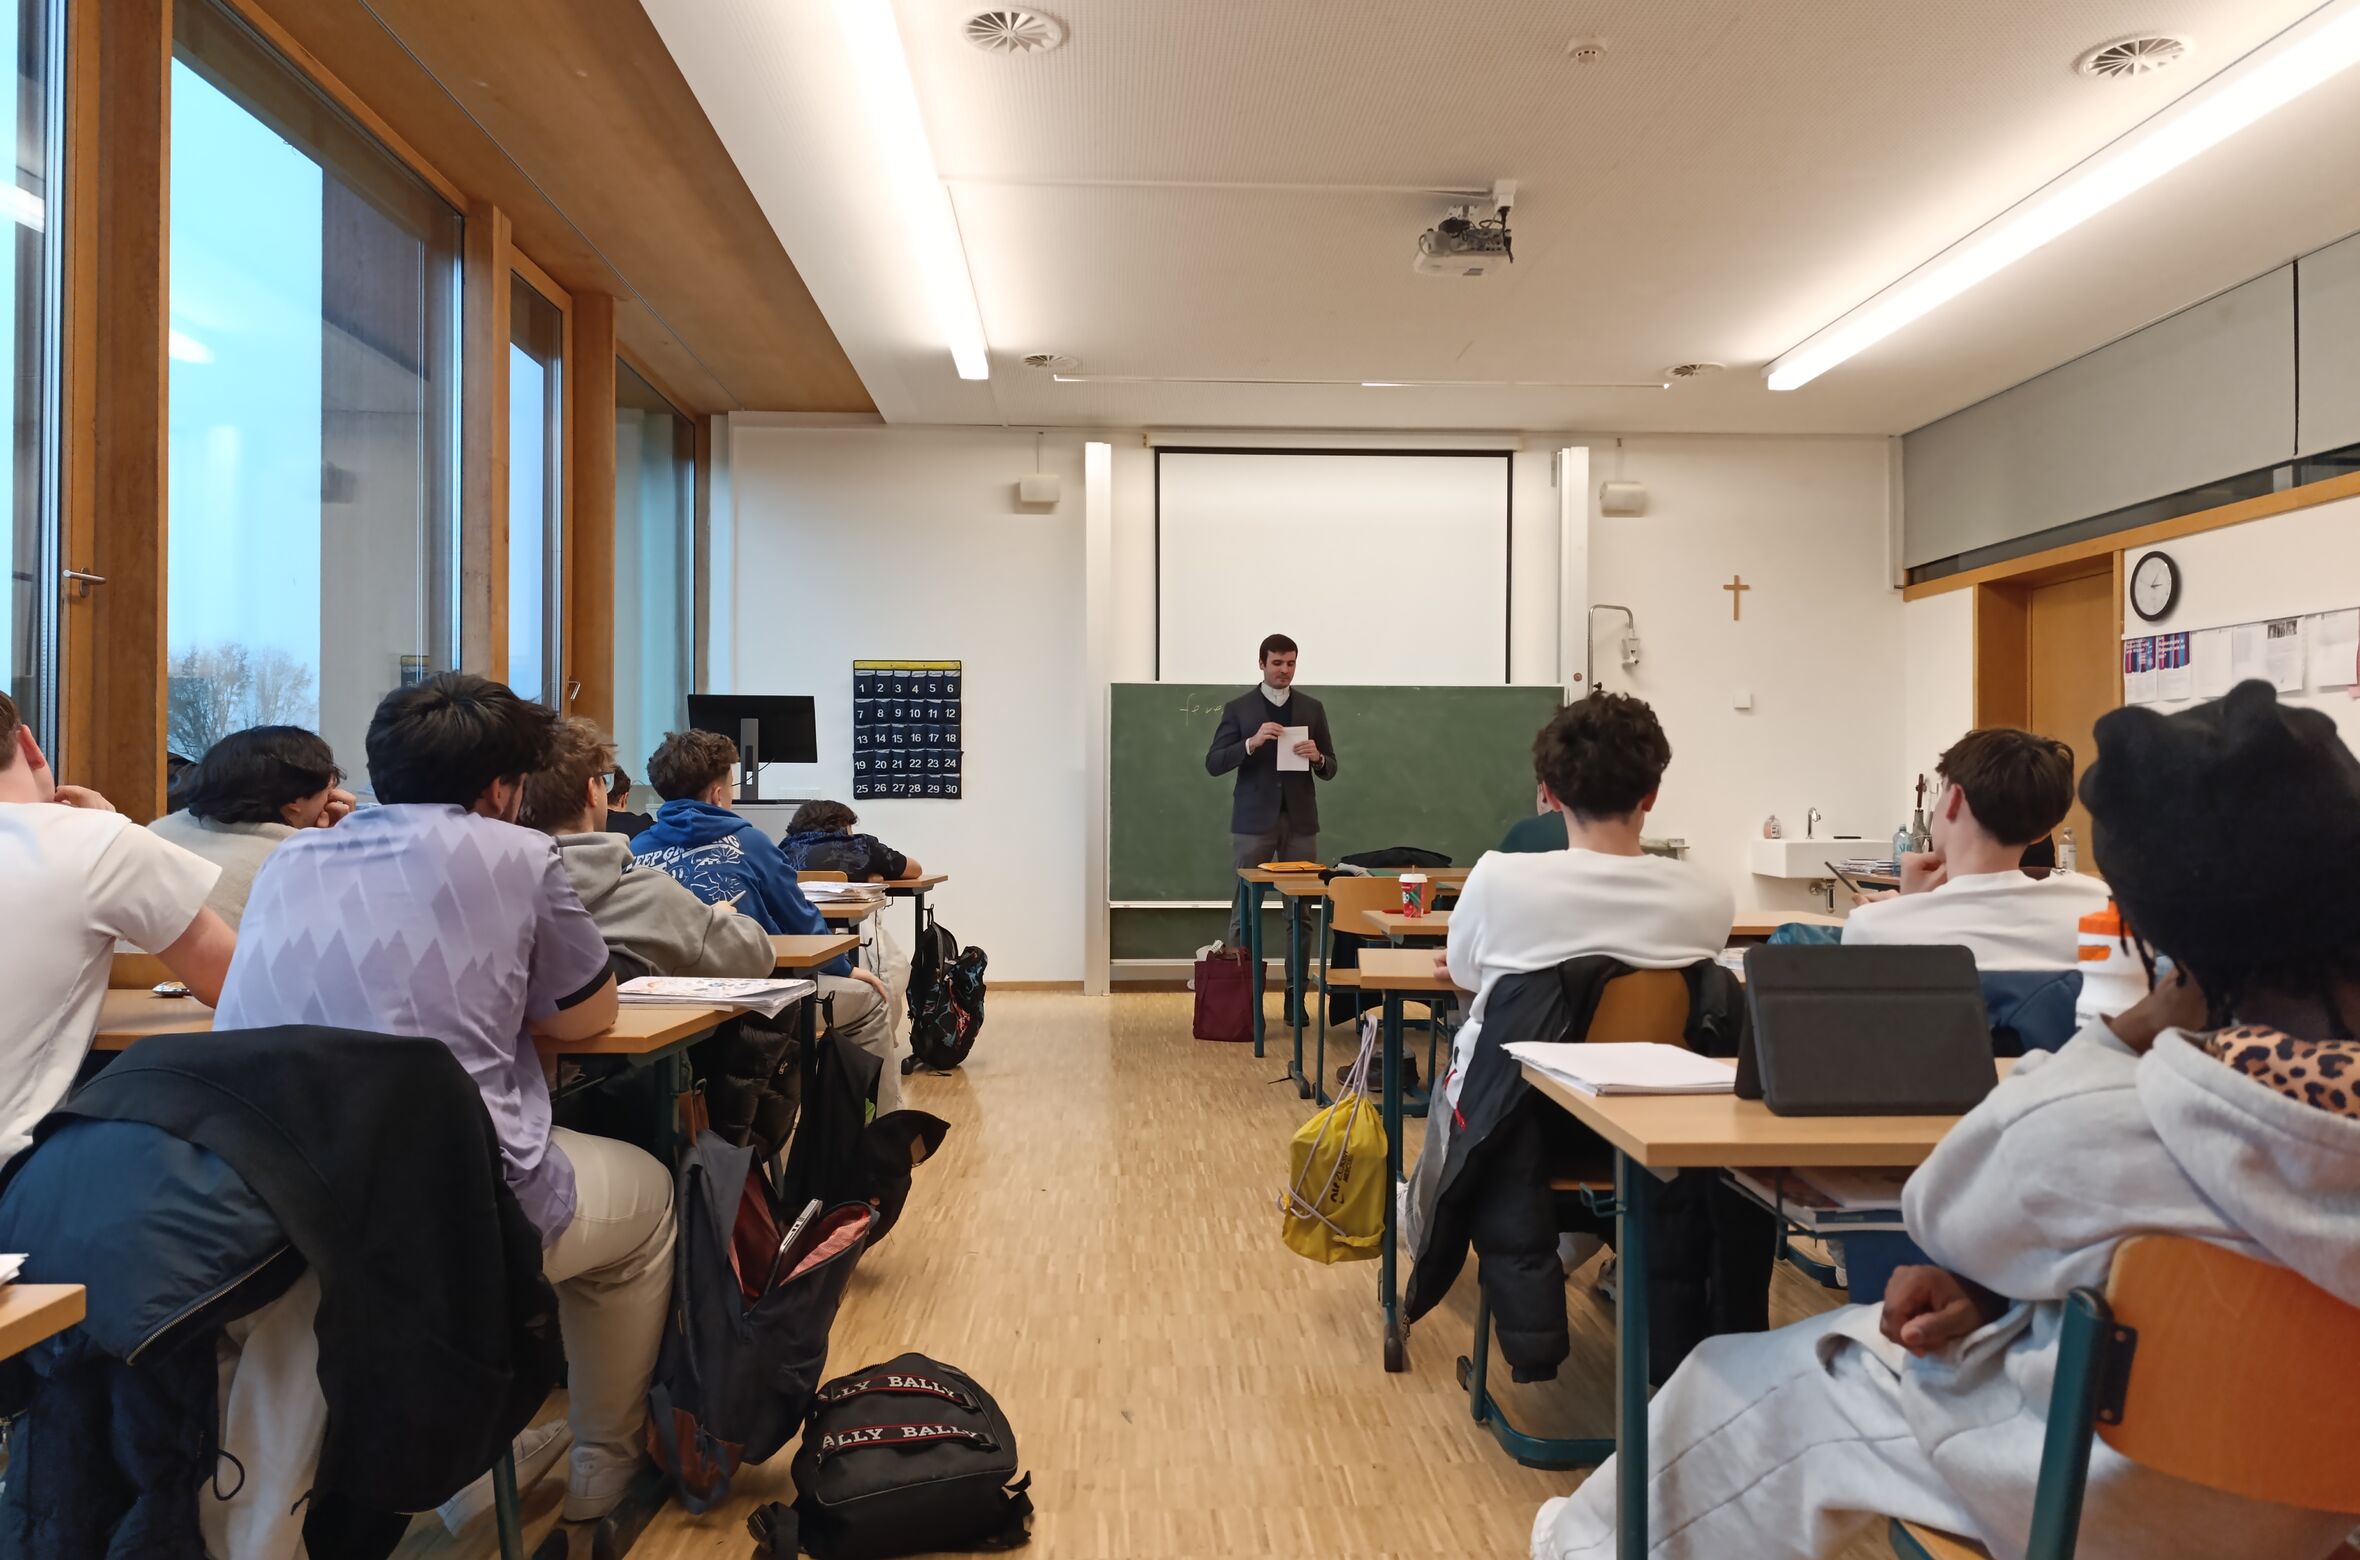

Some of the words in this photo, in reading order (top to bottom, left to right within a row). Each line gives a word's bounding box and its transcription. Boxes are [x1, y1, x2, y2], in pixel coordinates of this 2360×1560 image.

[859, 684, 865, 693] 1
[877, 684, 884, 693] 2
[895, 684, 902, 693] 3
[912, 684, 919, 694] 4
[929, 684, 936, 693] 5
[947, 684, 954, 693] 6
[857, 710, 864, 719] 7
[877, 709, 884, 718] 8
[895, 709, 902, 717] 9
[909, 709, 921, 718] 10
[928, 709, 938, 719] 11
[945, 709, 956, 718] 12
[857, 735, 868, 744] 13
[875, 734, 886, 743] 14
[892, 734, 903, 744] 15
[911, 733, 922, 742] 16
[928, 733, 939, 743] 17
[945, 733, 956, 743] 18
[855, 761, 866, 770] 19
[875, 760, 887, 769] 20
[892, 760, 902, 769] 21
[909, 759, 922, 768] 22
[927, 759, 939, 768] 23
[944, 759, 957, 768] 24
[856, 784, 869, 793] 25
[874, 784, 887, 792] 26
[892, 784, 905, 792] 27
[909, 784, 921, 793] 28
[927, 784, 940, 793] 29
[945, 784, 958, 794] 30
[888, 1376, 955, 1398] BALLY
[901, 1425, 978, 1438] BALLY
